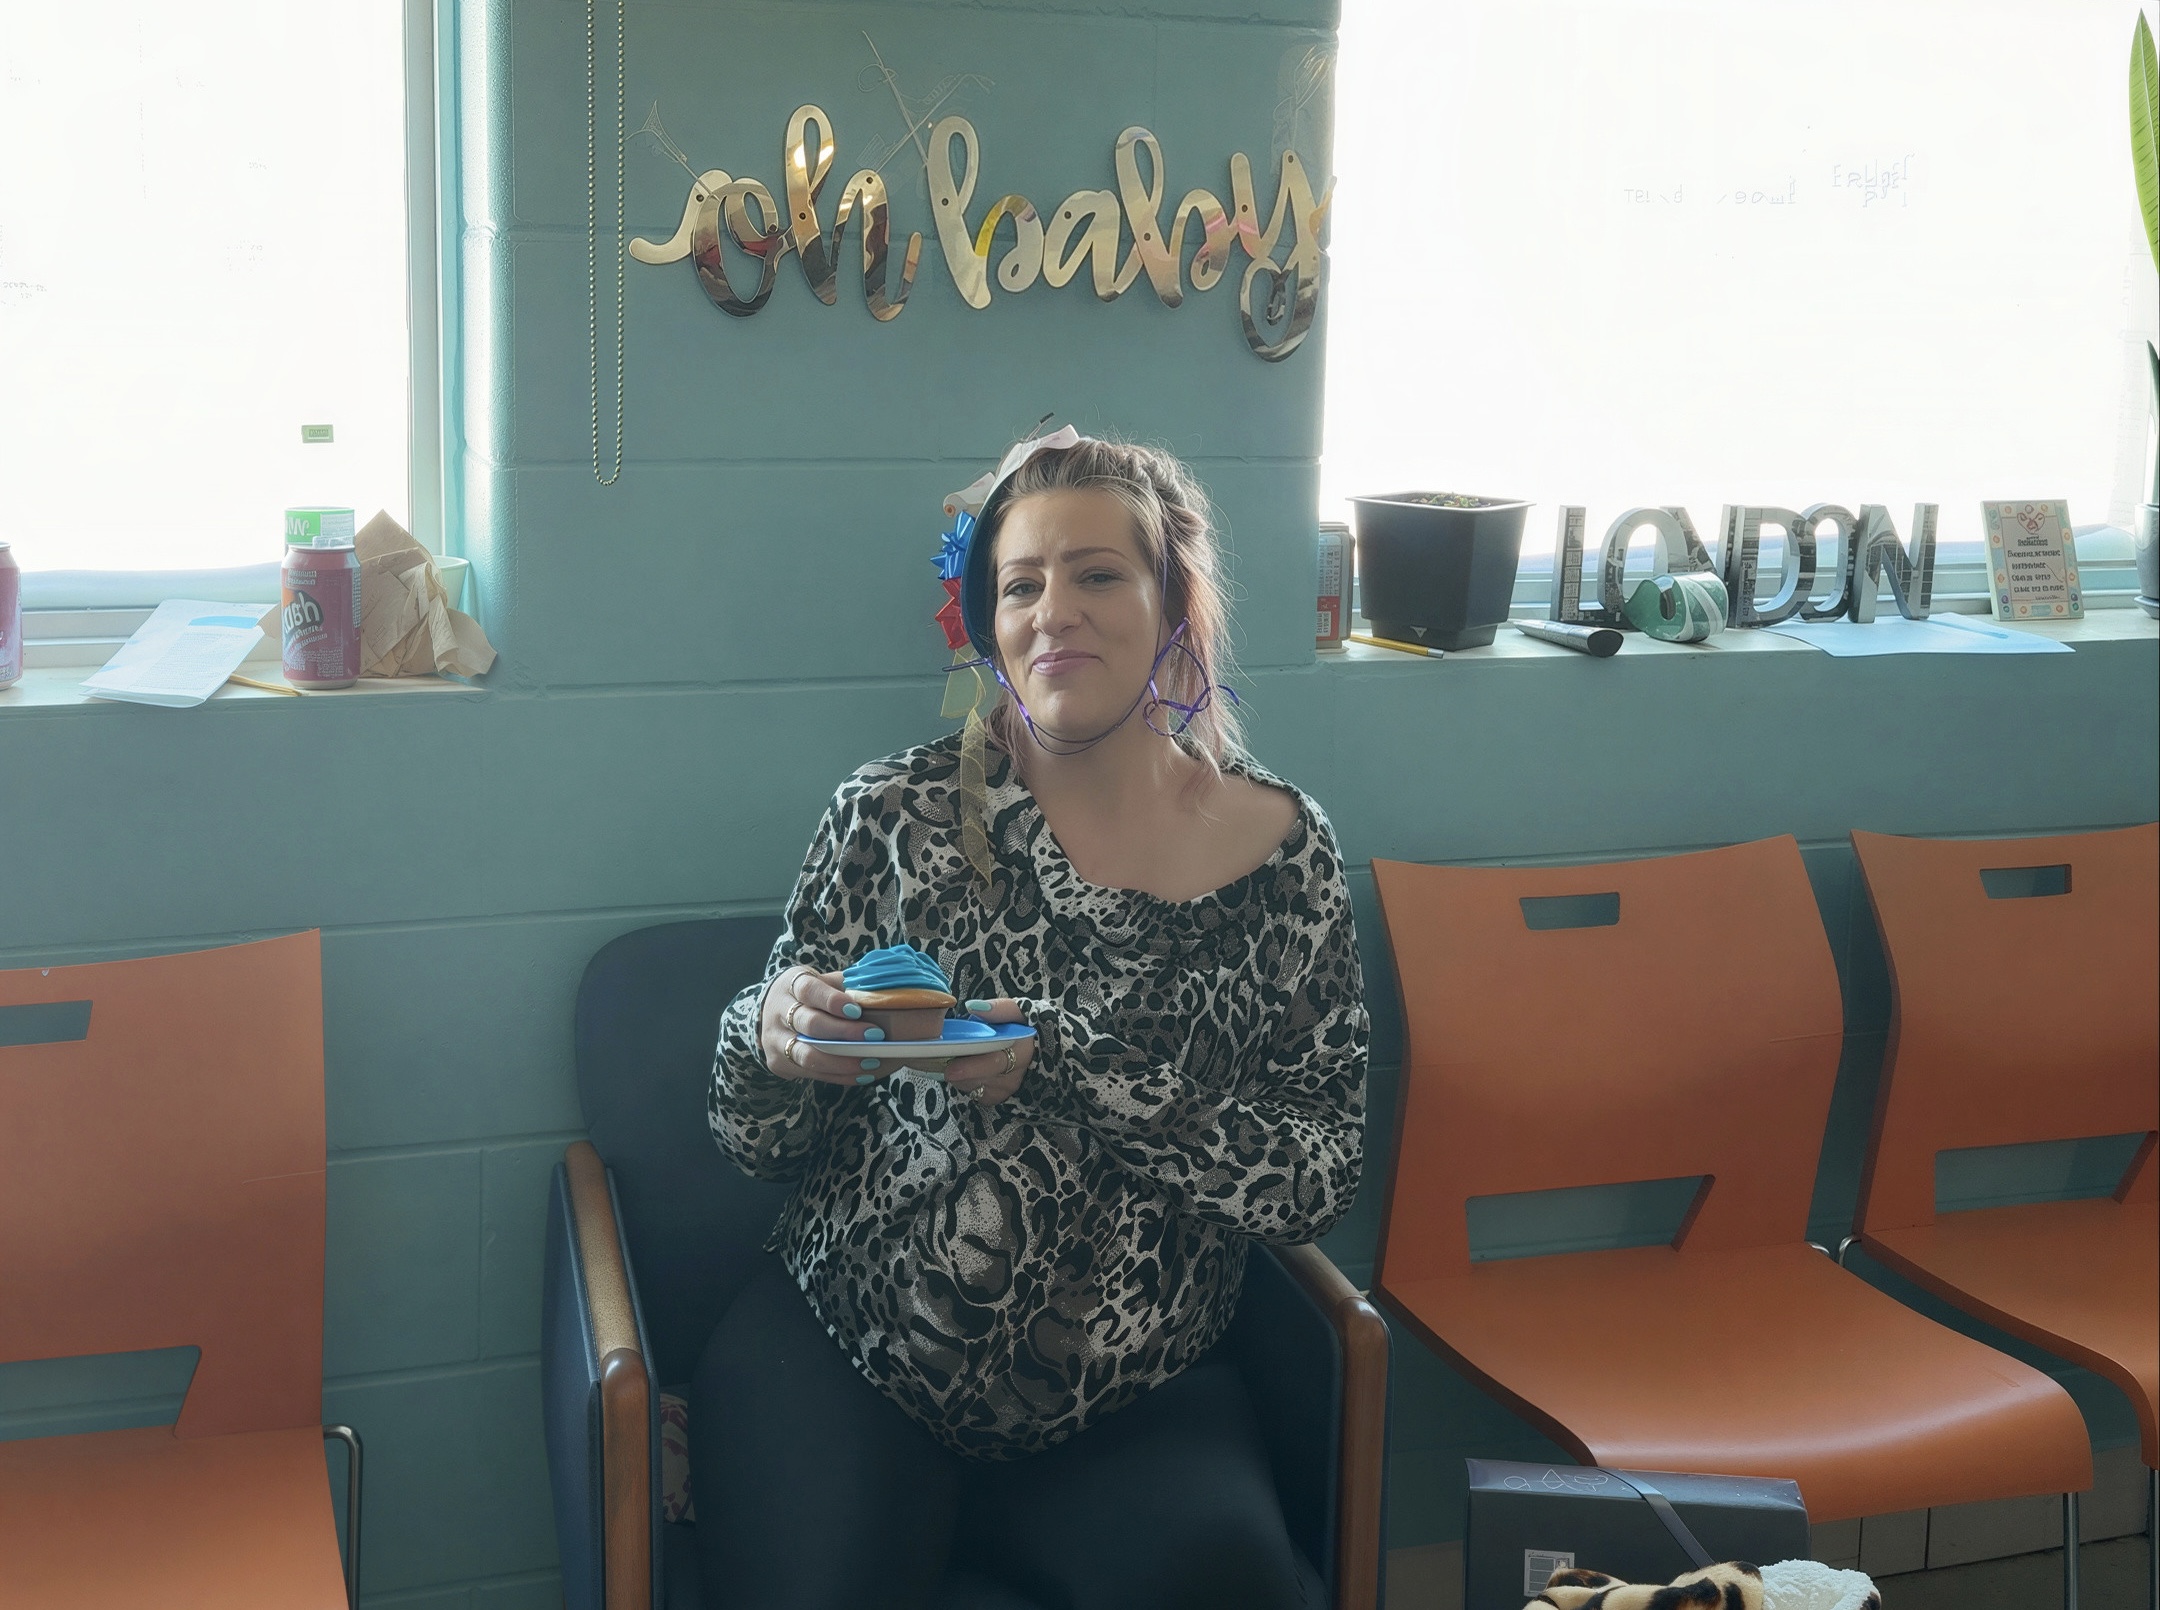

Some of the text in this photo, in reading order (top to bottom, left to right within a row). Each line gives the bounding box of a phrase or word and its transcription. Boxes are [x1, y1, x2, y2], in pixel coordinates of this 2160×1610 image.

[629, 104, 1337, 362] oh baby
[1550, 502, 1940, 629] LONDON
